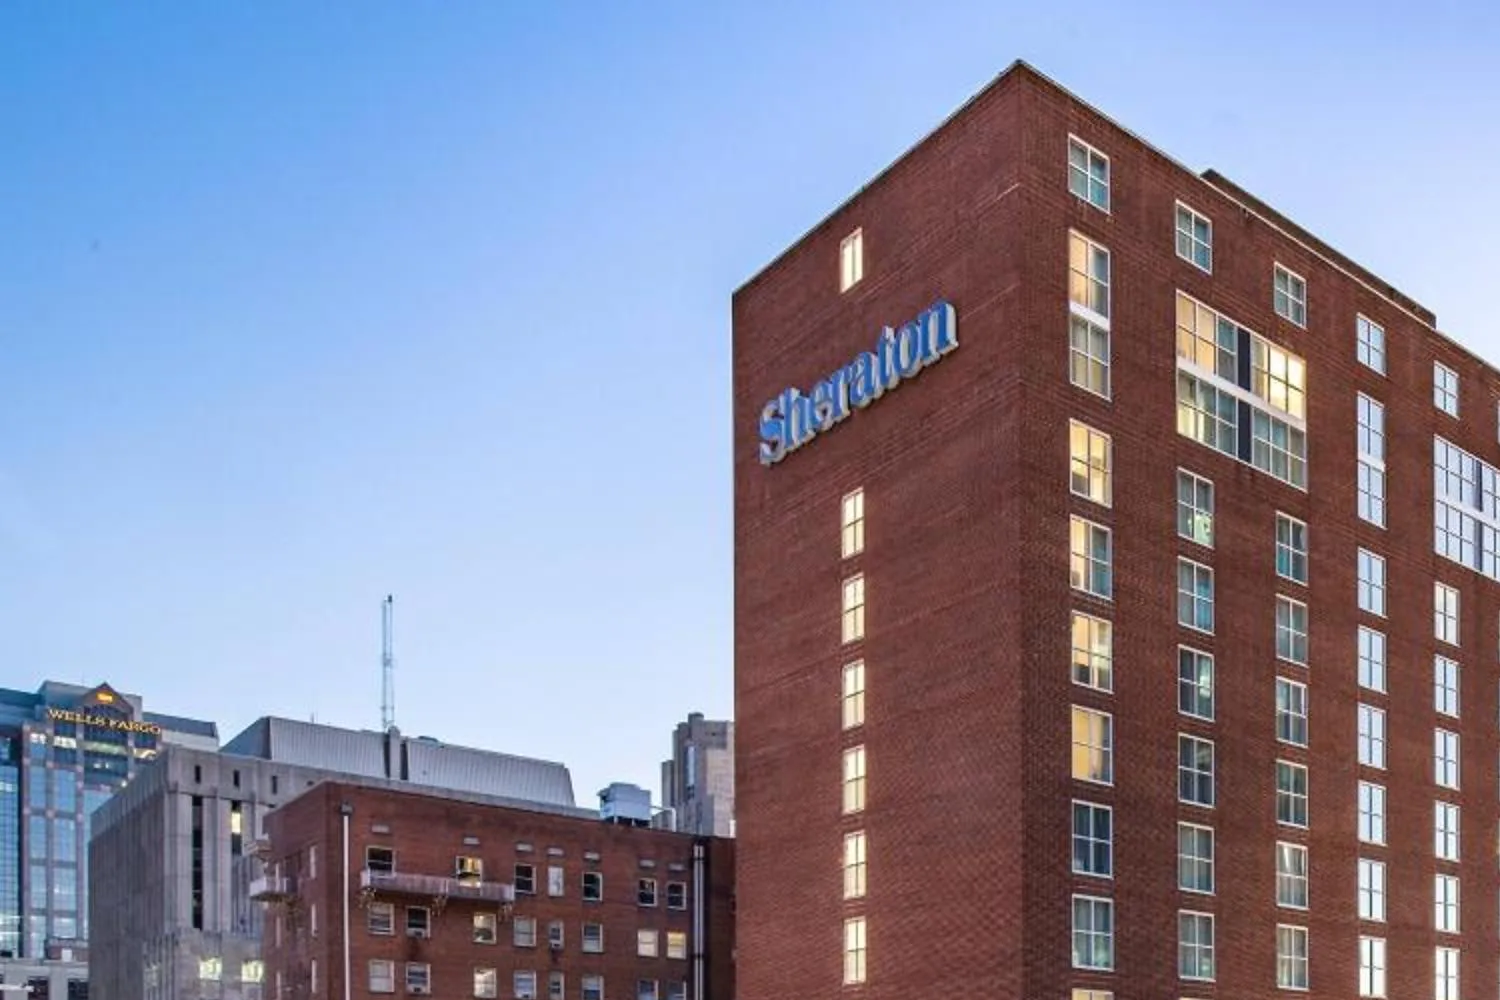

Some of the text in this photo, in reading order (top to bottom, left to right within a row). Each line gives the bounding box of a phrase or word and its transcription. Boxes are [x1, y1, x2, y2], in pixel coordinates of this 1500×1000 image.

[759, 299, 959, 466] Sheraton
[48, 708, 161, 736] WELLS FARGO
